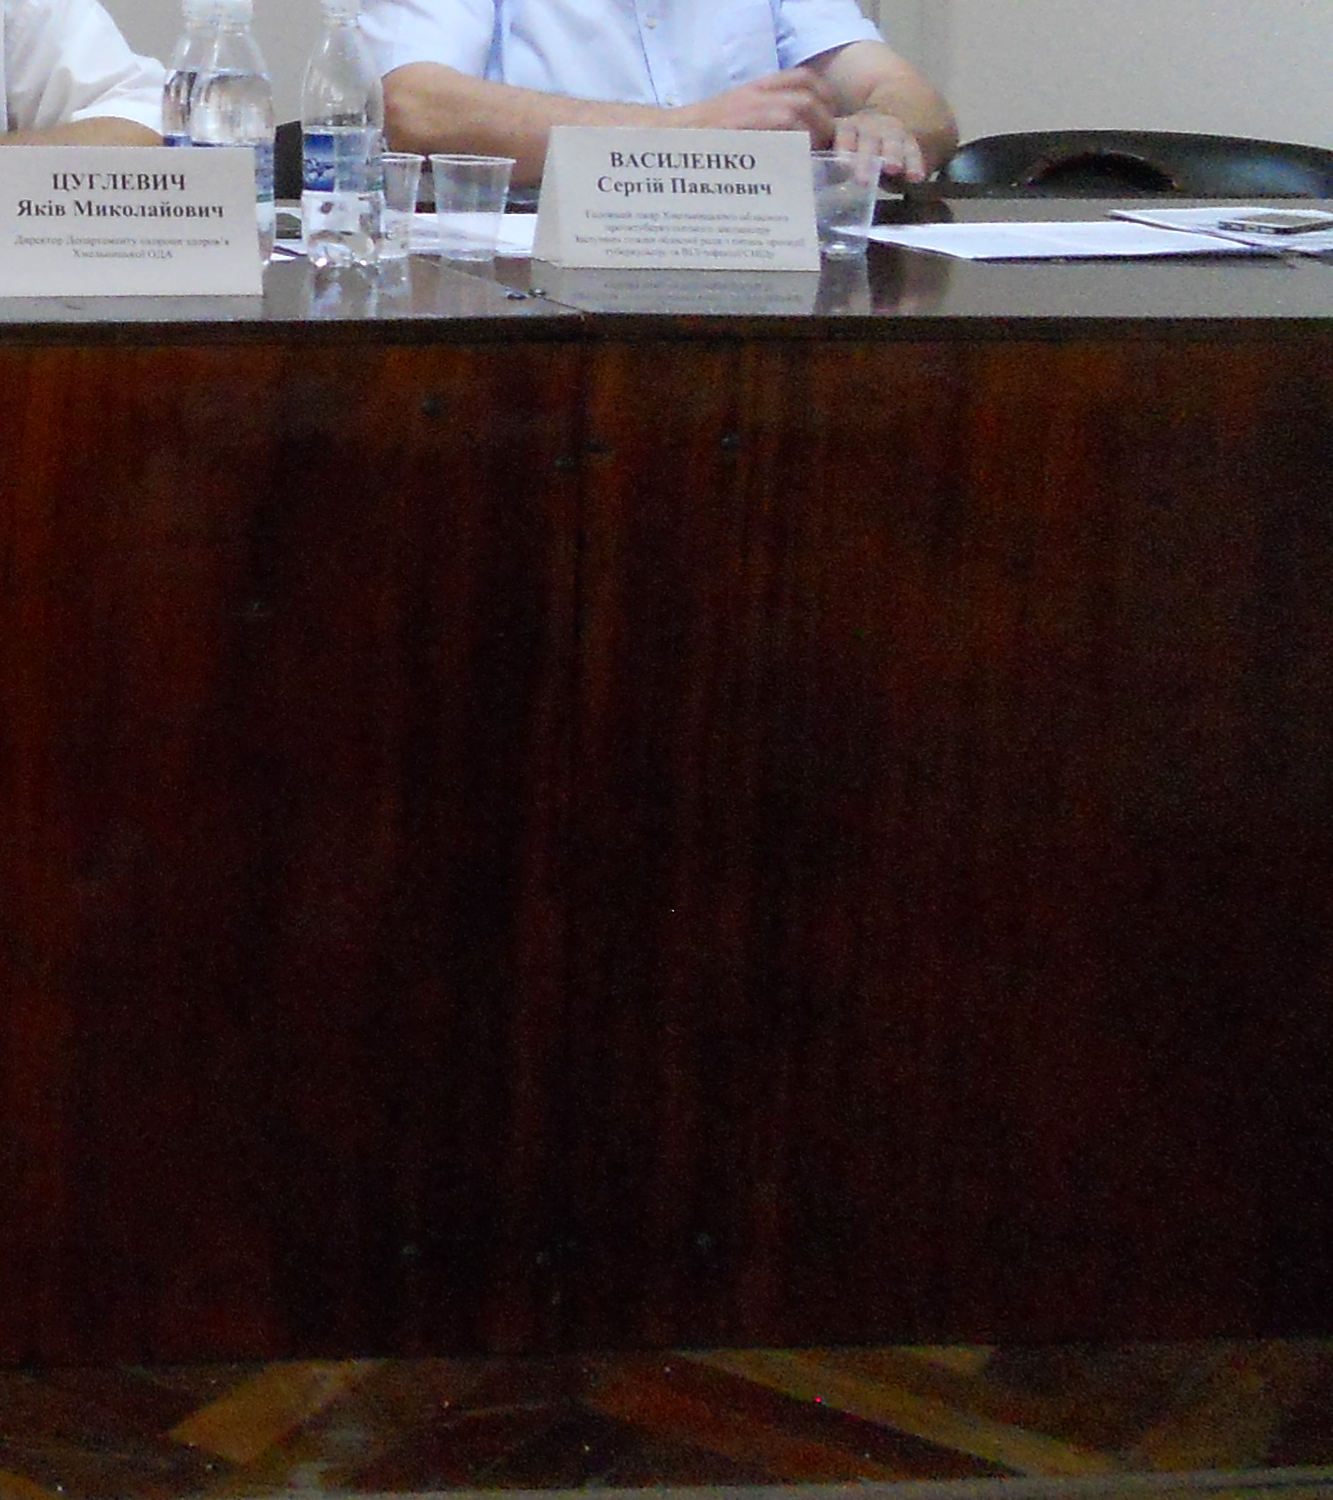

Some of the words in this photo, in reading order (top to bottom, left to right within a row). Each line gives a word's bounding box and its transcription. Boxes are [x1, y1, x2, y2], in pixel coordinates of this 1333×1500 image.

[610, 151, 756, 171] ВАСИЛЕНКО
[52, 173, 187, 192] ЦУГЛЕВИЧ
[597, 176, 664, 197] Сергій
[671, 177, 773, 196] Павлович
[17, 200, 66, 217] Яків
[73, 200, 224, 218] Миколайович
